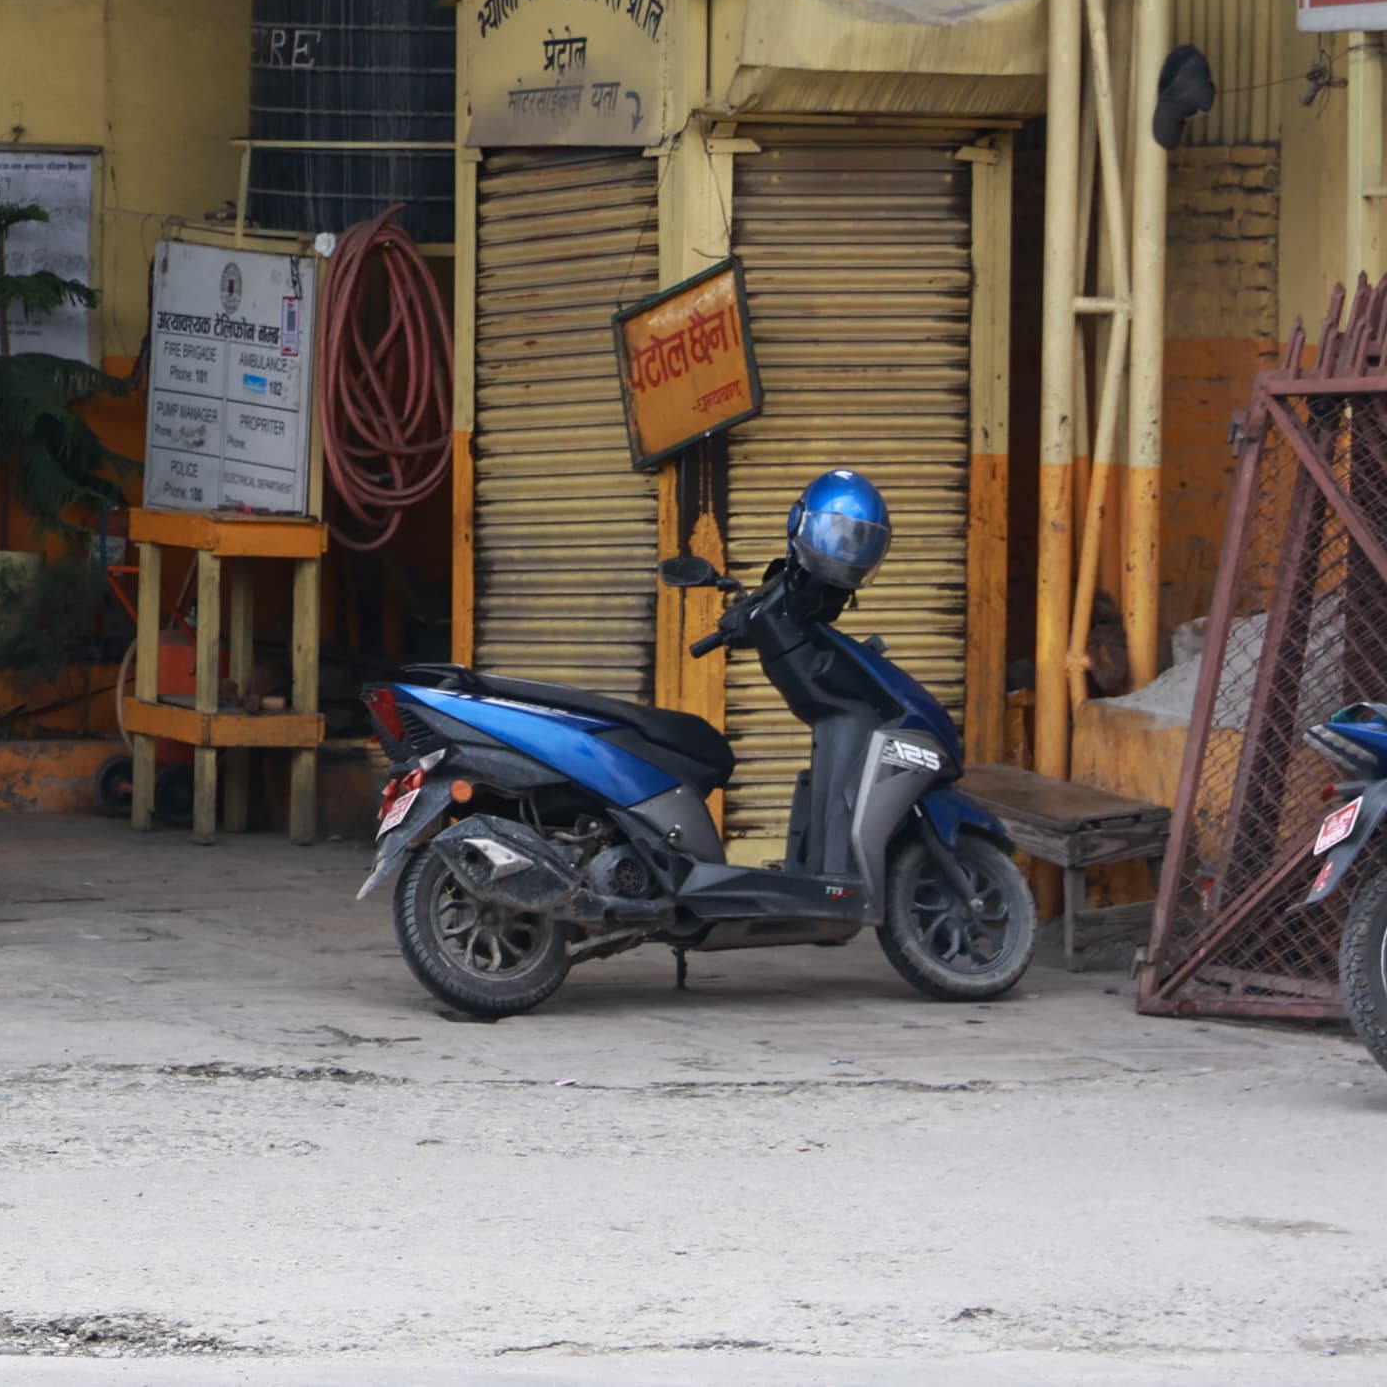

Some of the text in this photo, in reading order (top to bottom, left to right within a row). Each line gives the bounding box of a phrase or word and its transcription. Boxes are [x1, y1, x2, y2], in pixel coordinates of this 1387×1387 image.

[258, 324, 280, 345] नम्ब
[164, 342, 217, 363] FIRE BRIGADE
[239, 352, 287, 374] AMBULANCE
[195, 369, 209, 384] 101
[170, 459, 200, 479] POLICE
[893, 740, 942, 771] 125
